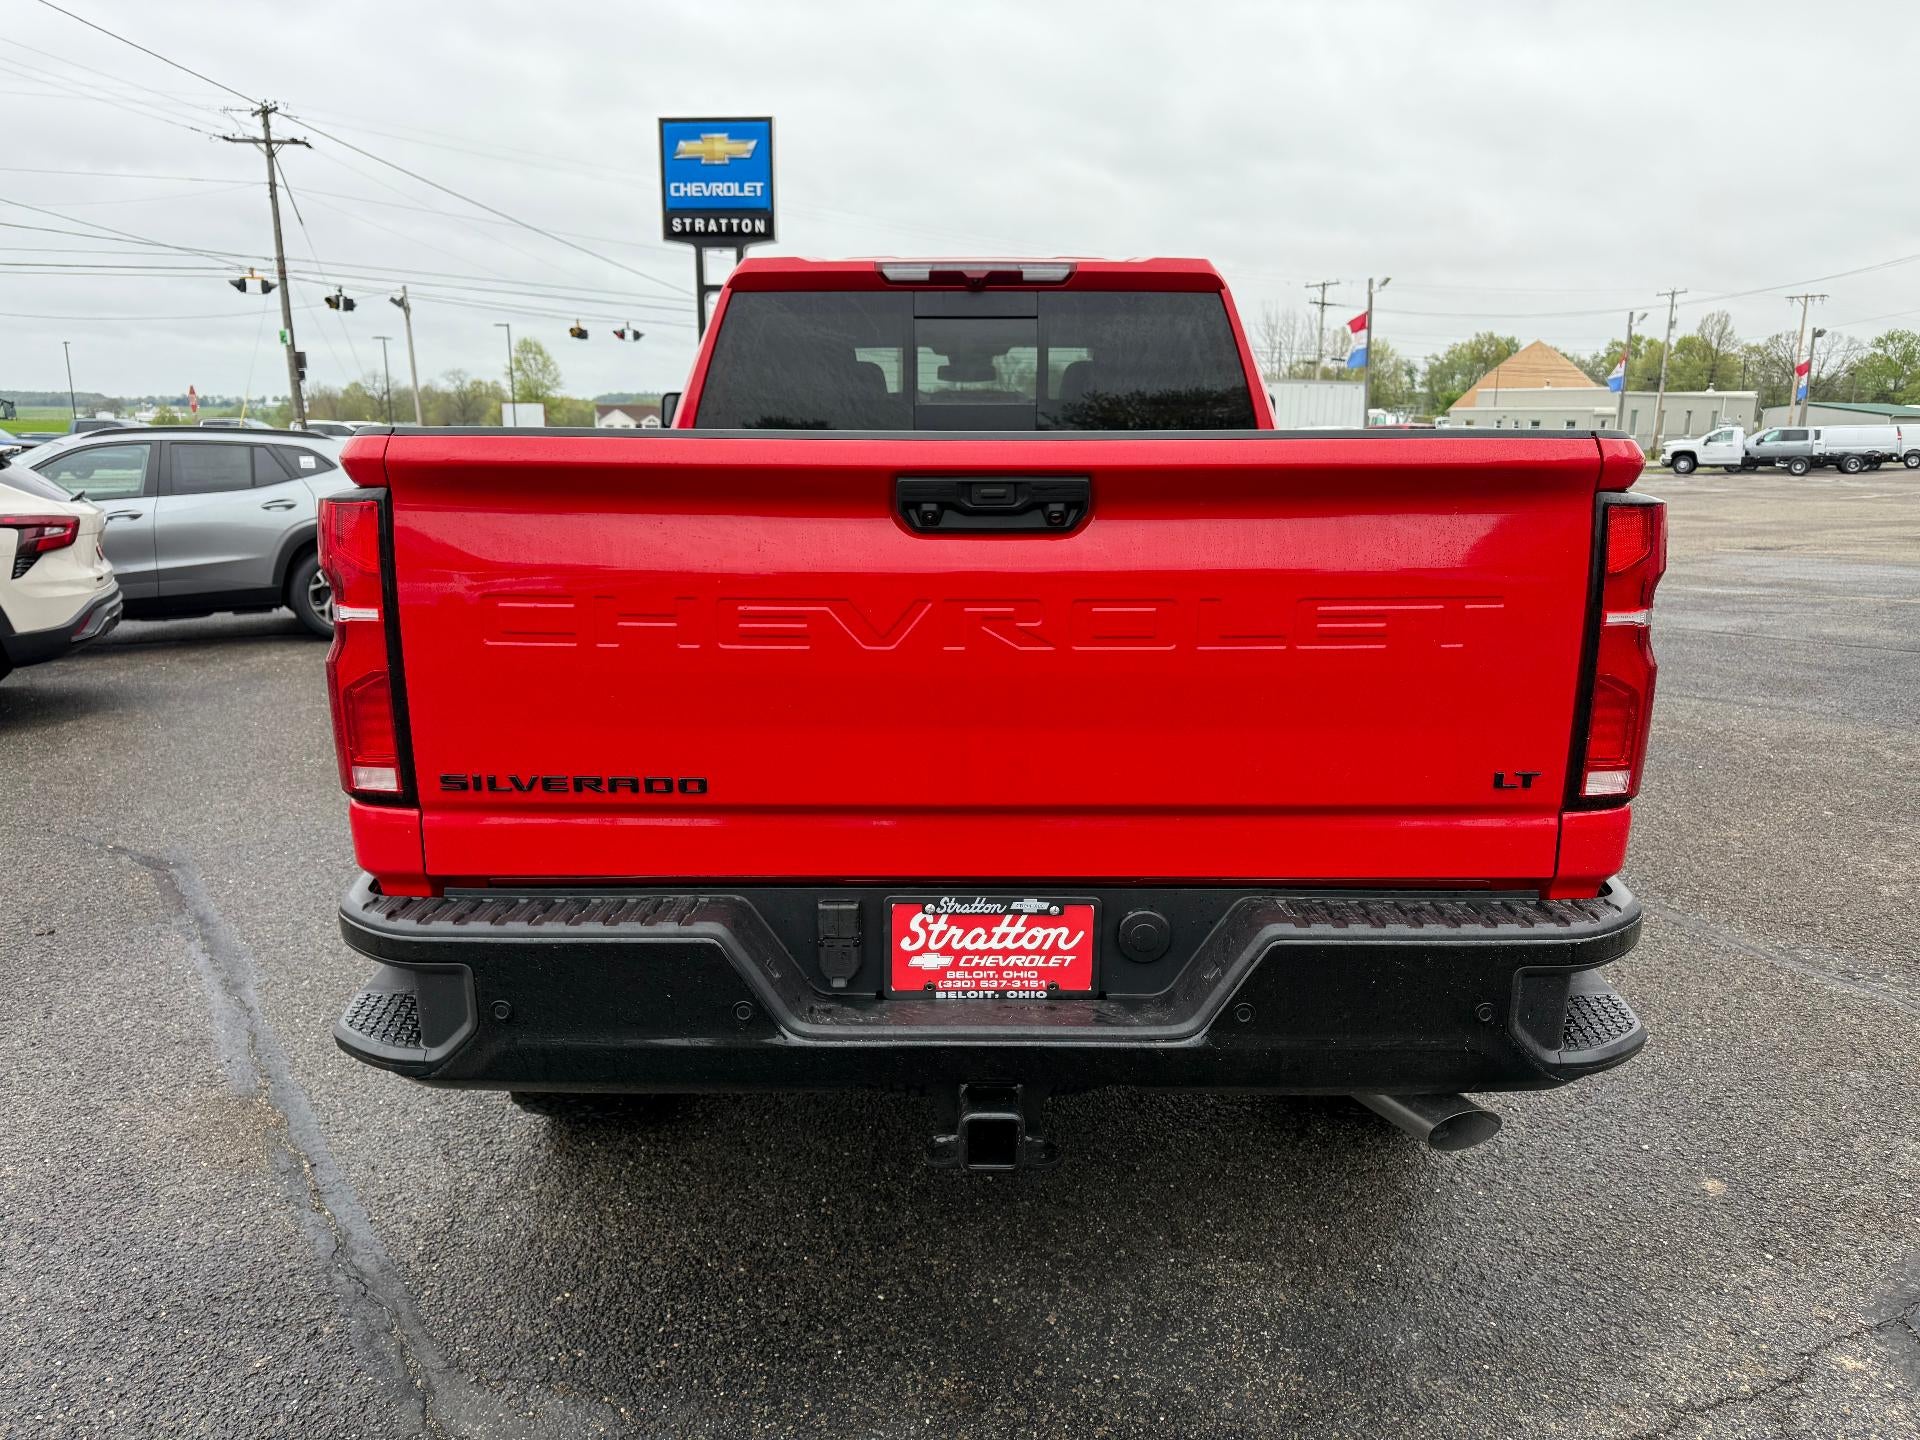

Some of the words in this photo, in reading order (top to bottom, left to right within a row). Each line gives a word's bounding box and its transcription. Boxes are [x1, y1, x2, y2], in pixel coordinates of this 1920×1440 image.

[669, 182, 764, 197] CHEVROLET
[671, 218, 765, 233] STRATTON
[481, 594, 1505, 653] CHEVROLET
[439, 773, 708, 794] SILVERADO
[1493, 771, 1541, 789] LT
[936, 897, 1006, 914] Stratton
[900, 912, 1085, 951] Stratton
[958, 955, 1077, 967] CHEVROLET
[1002, 970, 1038, 979] OHIO
[938, 980, 976, 988] (330)
[979, 980, 1046, 988] 537-3151
[935, 990, 1000, 999] BELOIT,
[1006, 990, 1048, 999] OHIO
